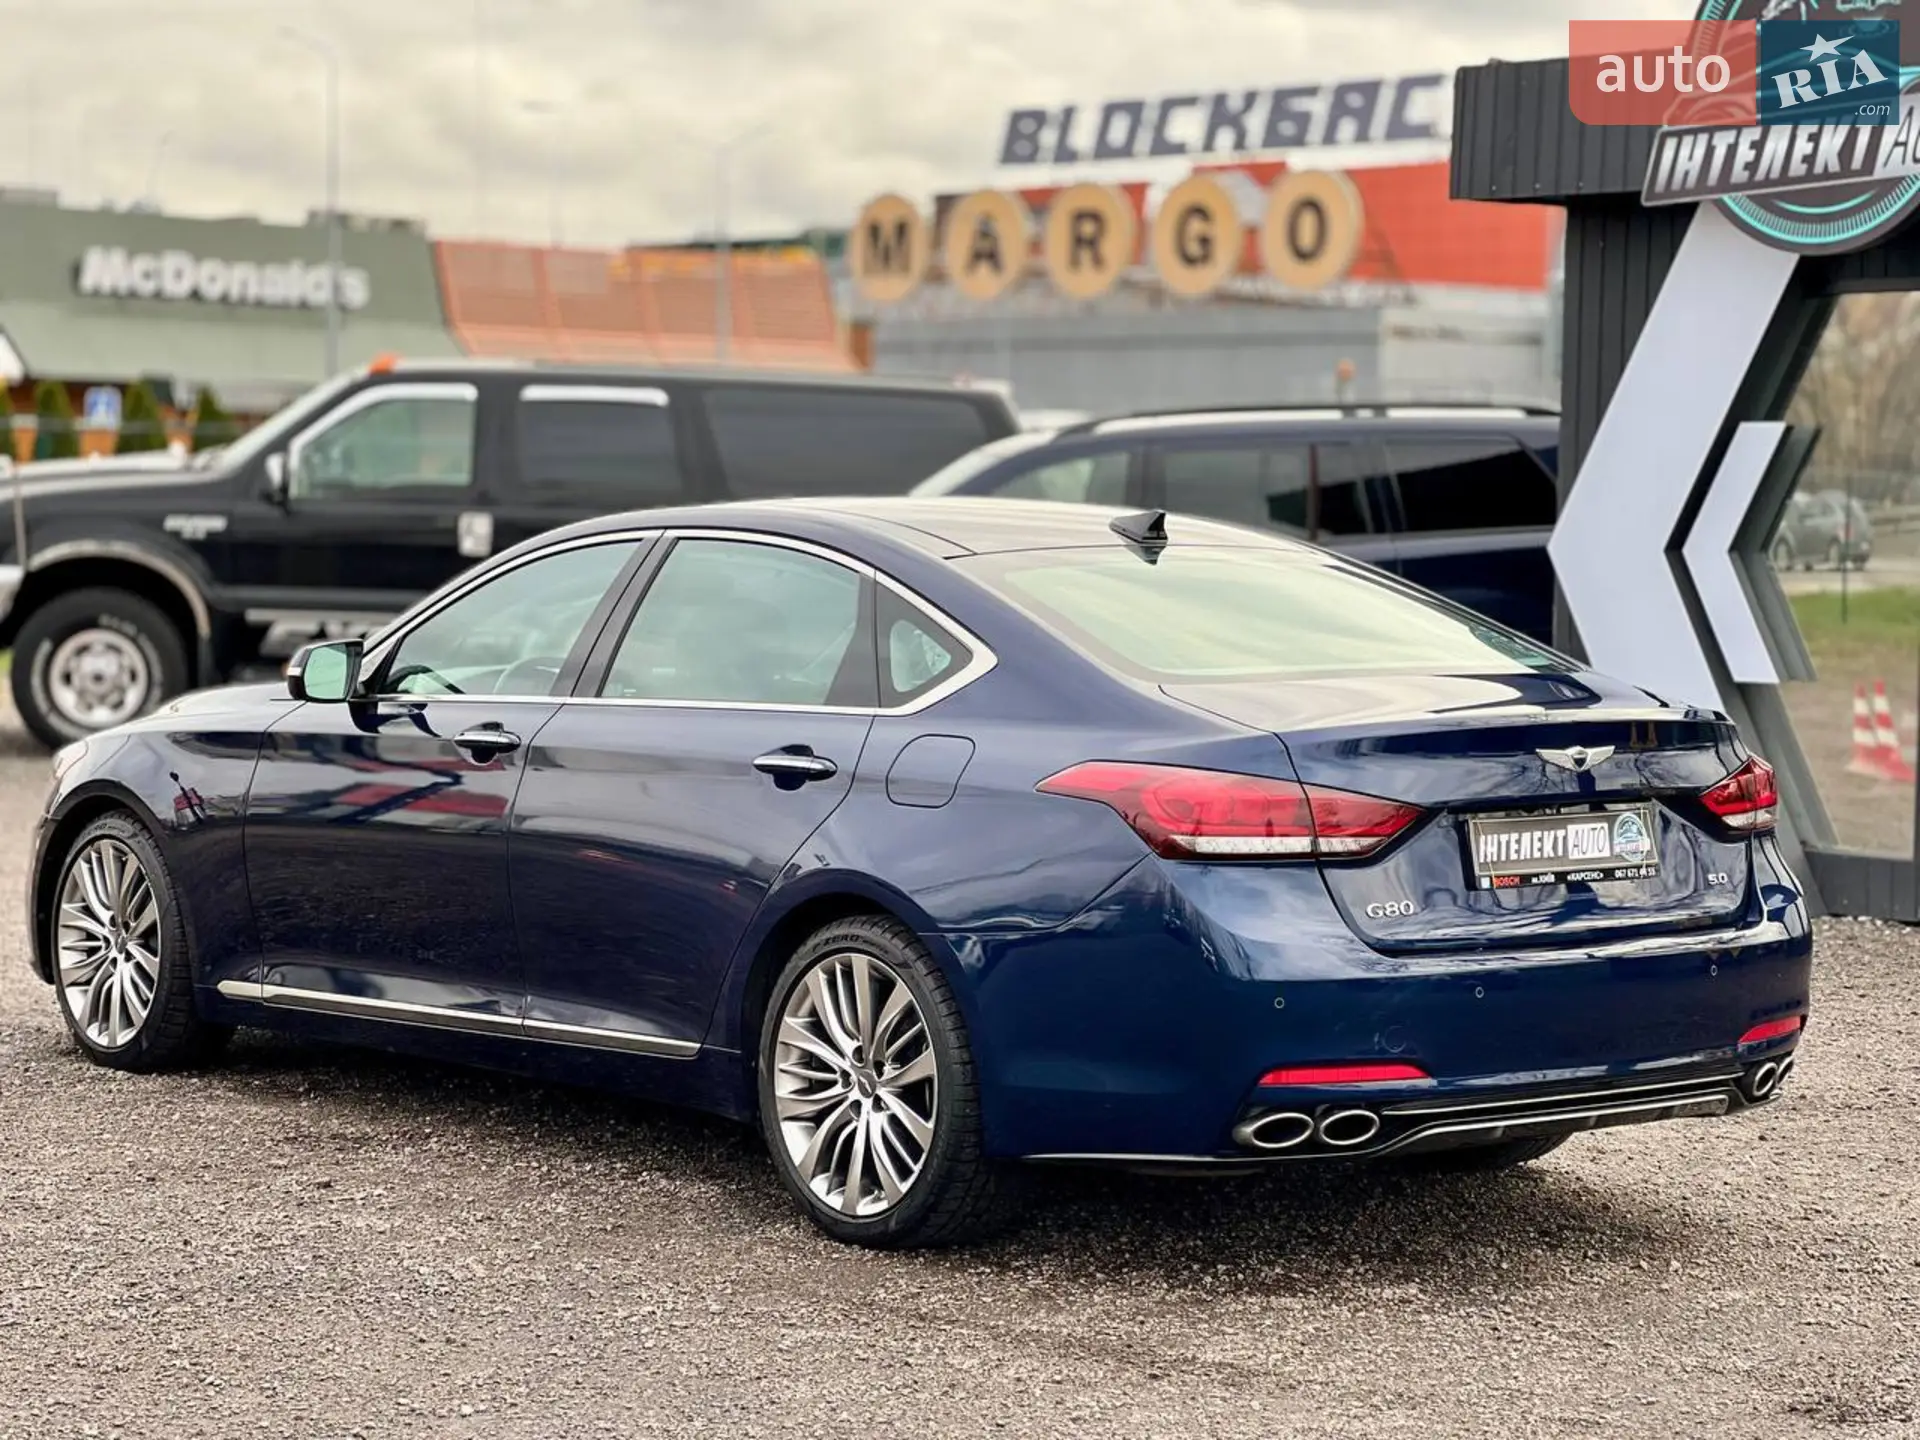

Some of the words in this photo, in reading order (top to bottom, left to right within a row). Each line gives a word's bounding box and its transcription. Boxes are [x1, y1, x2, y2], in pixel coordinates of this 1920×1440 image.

[863, 196, 1330, 275] MARGO
[78, 246, 371, 310] McDonald's
[1571, 825, 1607, 857] AUTO
[1492, 876, 1520, 888] BOSCH
[1366, 900, 1415, 918] G80
